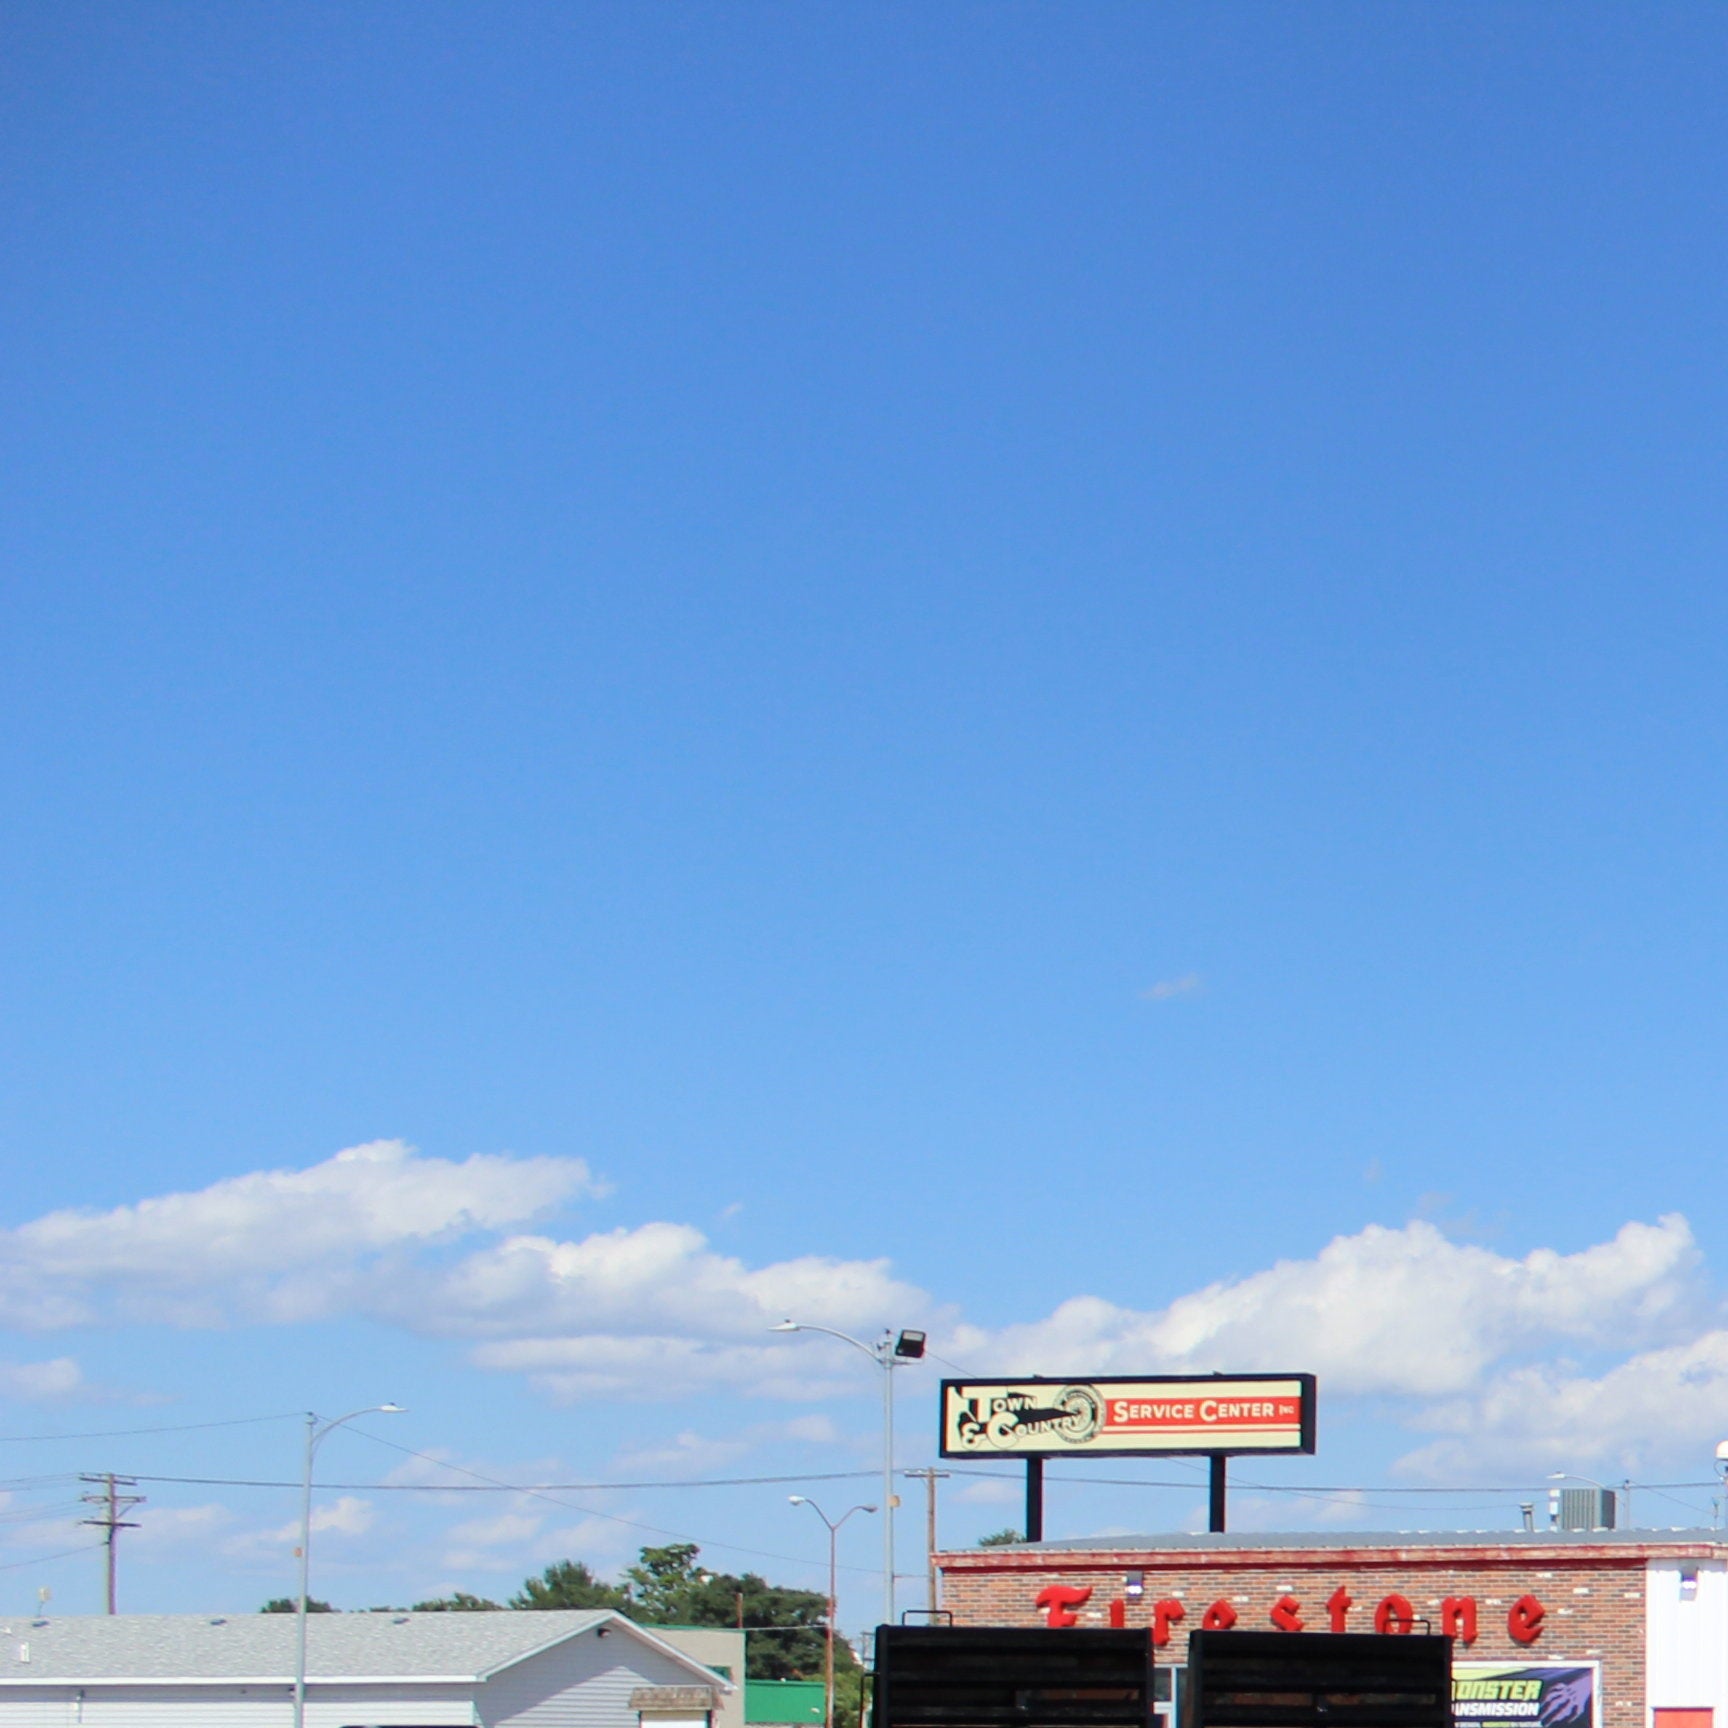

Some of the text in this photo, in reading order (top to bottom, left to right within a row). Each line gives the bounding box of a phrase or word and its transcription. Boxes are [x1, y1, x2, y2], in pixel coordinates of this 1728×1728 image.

[1113, 1400, 1195, 1423] SERVICE
[1199, 1399, 1276, 1422] CENTER
[1452, 1702, 1540, 1717] ANSMISSION
